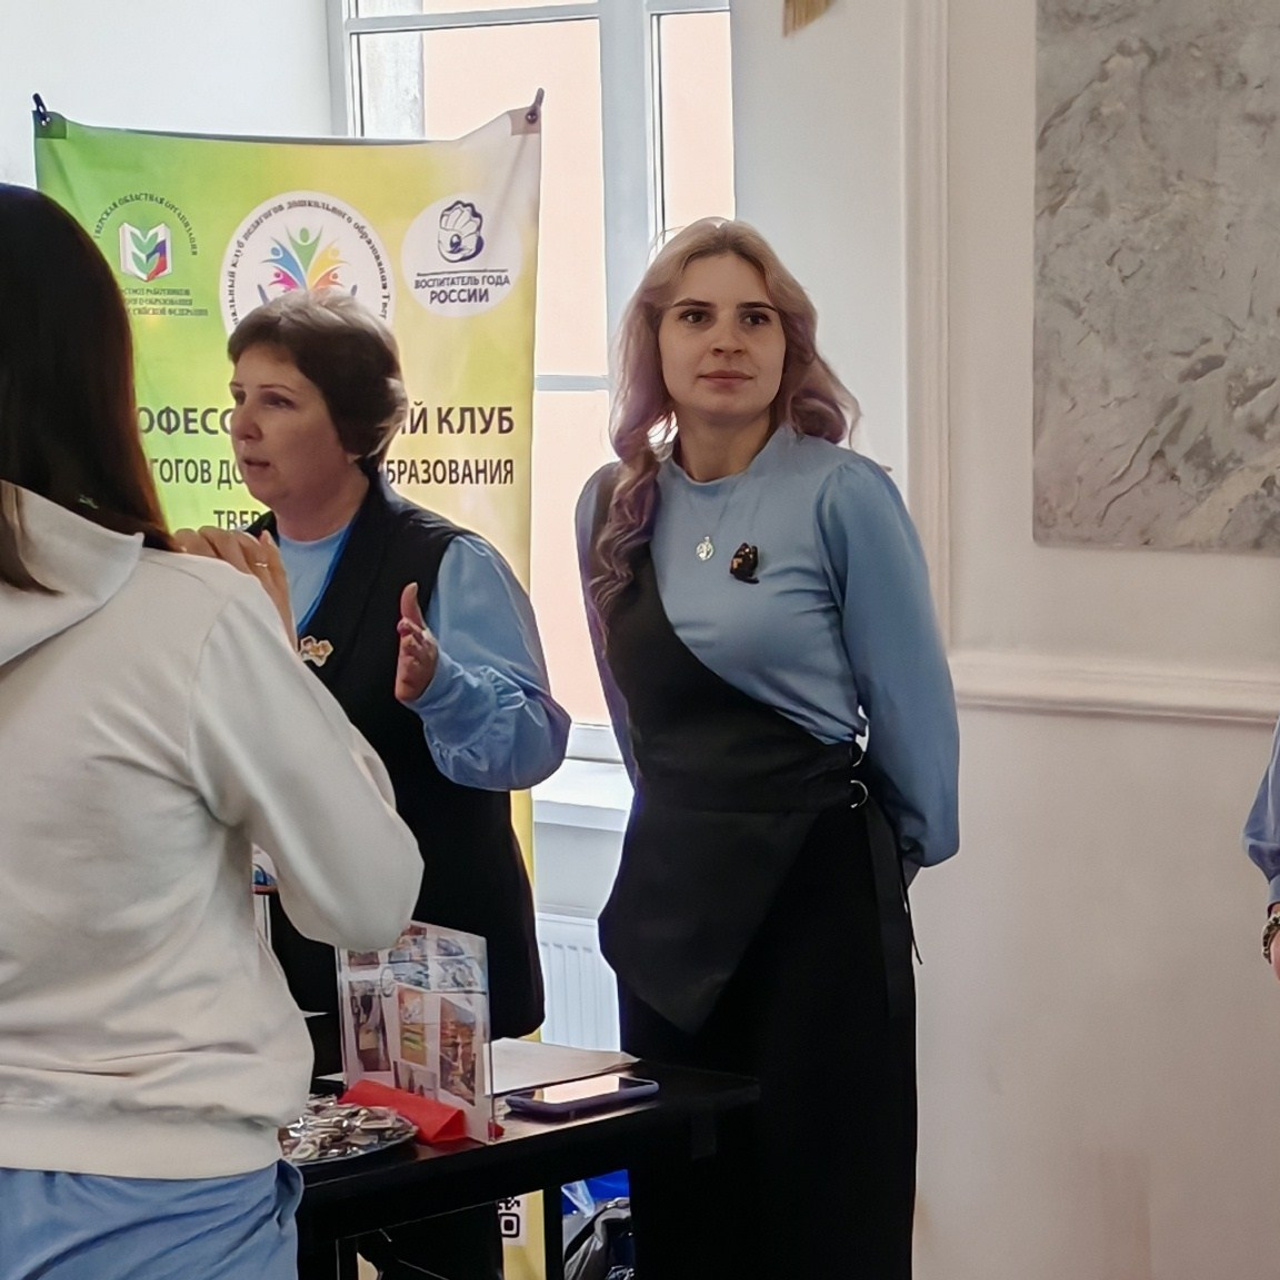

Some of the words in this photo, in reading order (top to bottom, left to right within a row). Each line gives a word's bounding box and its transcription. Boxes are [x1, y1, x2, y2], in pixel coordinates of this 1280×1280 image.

[414, 276, 480, 289] ВОСПИТАТЕЛЬ
[481, 275, 510, 286] ГОДА
[430, 288, 489, 304] РОССИИ
[436, 406, 514, 435] КЛУБ
[386, 459, 514, 484] БРАЗОВАНИЯ
